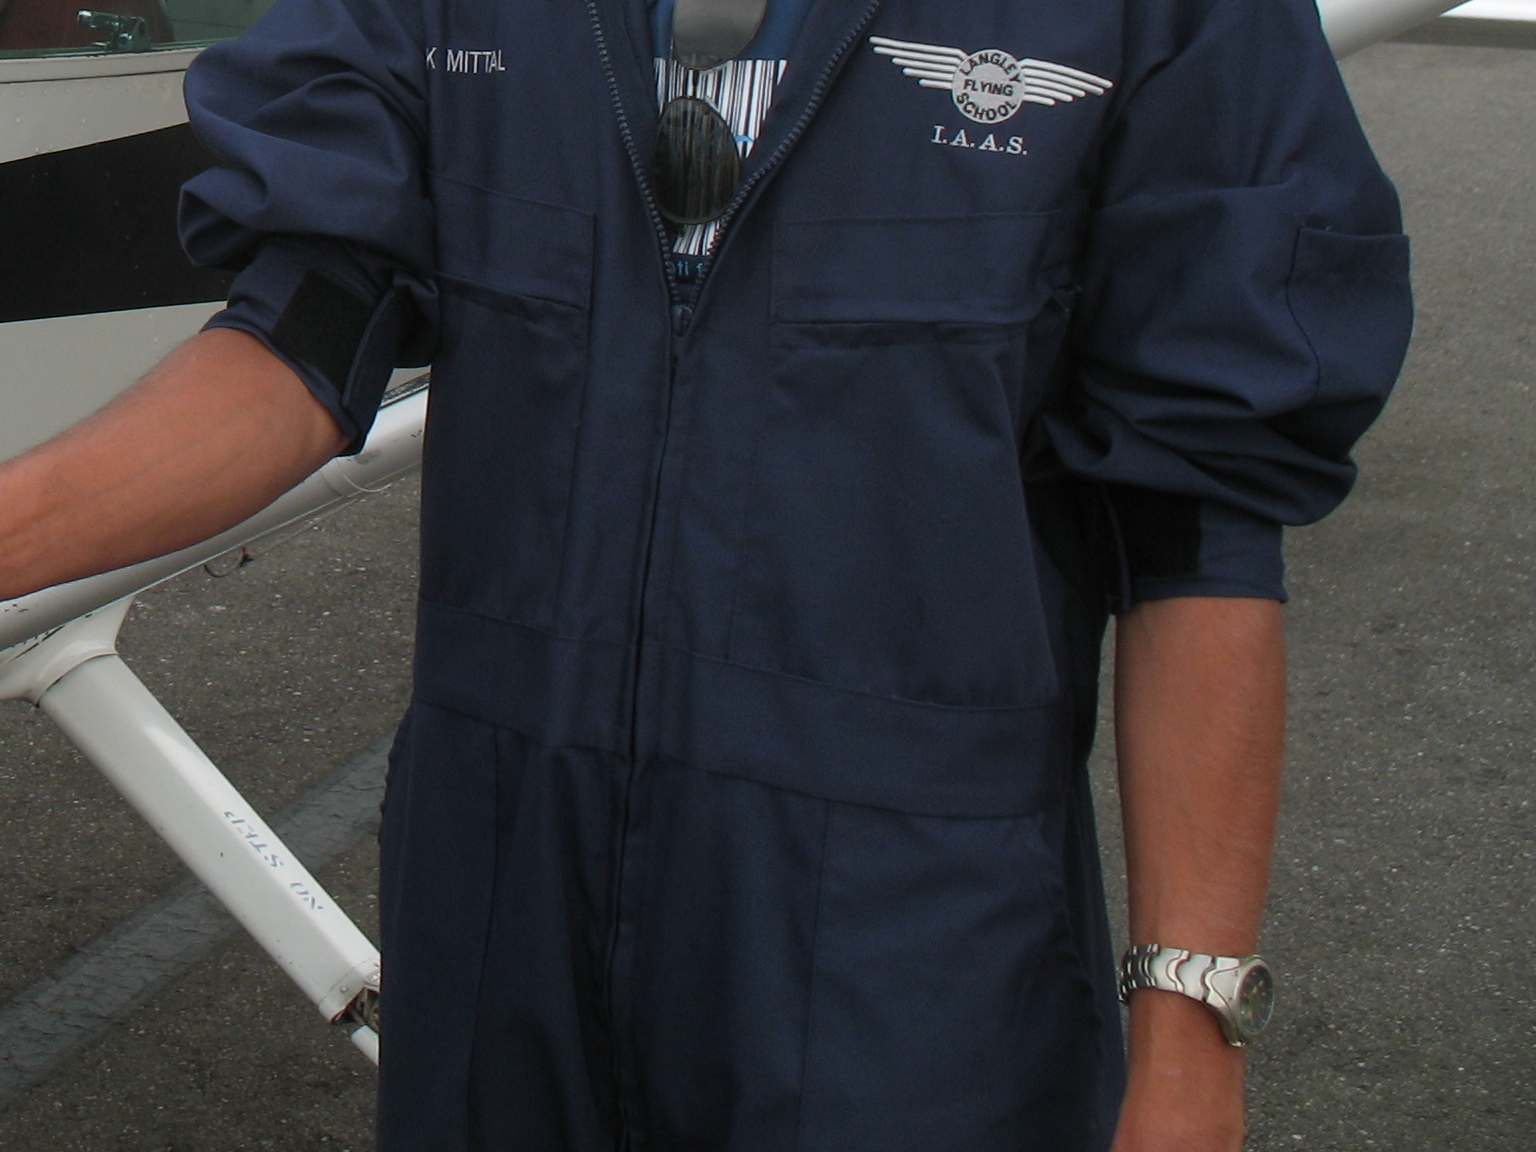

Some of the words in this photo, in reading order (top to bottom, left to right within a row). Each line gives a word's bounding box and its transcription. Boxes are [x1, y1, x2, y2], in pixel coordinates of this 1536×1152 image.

[446, 49, 506, 74] MITTAL
[959, 52, 1022, 77] LANGLEY
[963, 78, 1014, 97] FLYING
[956, 92, 1018, 121] SCHOOL
[223, 810, 284, 868] STEP
[290, 881, 324, 910] NO
